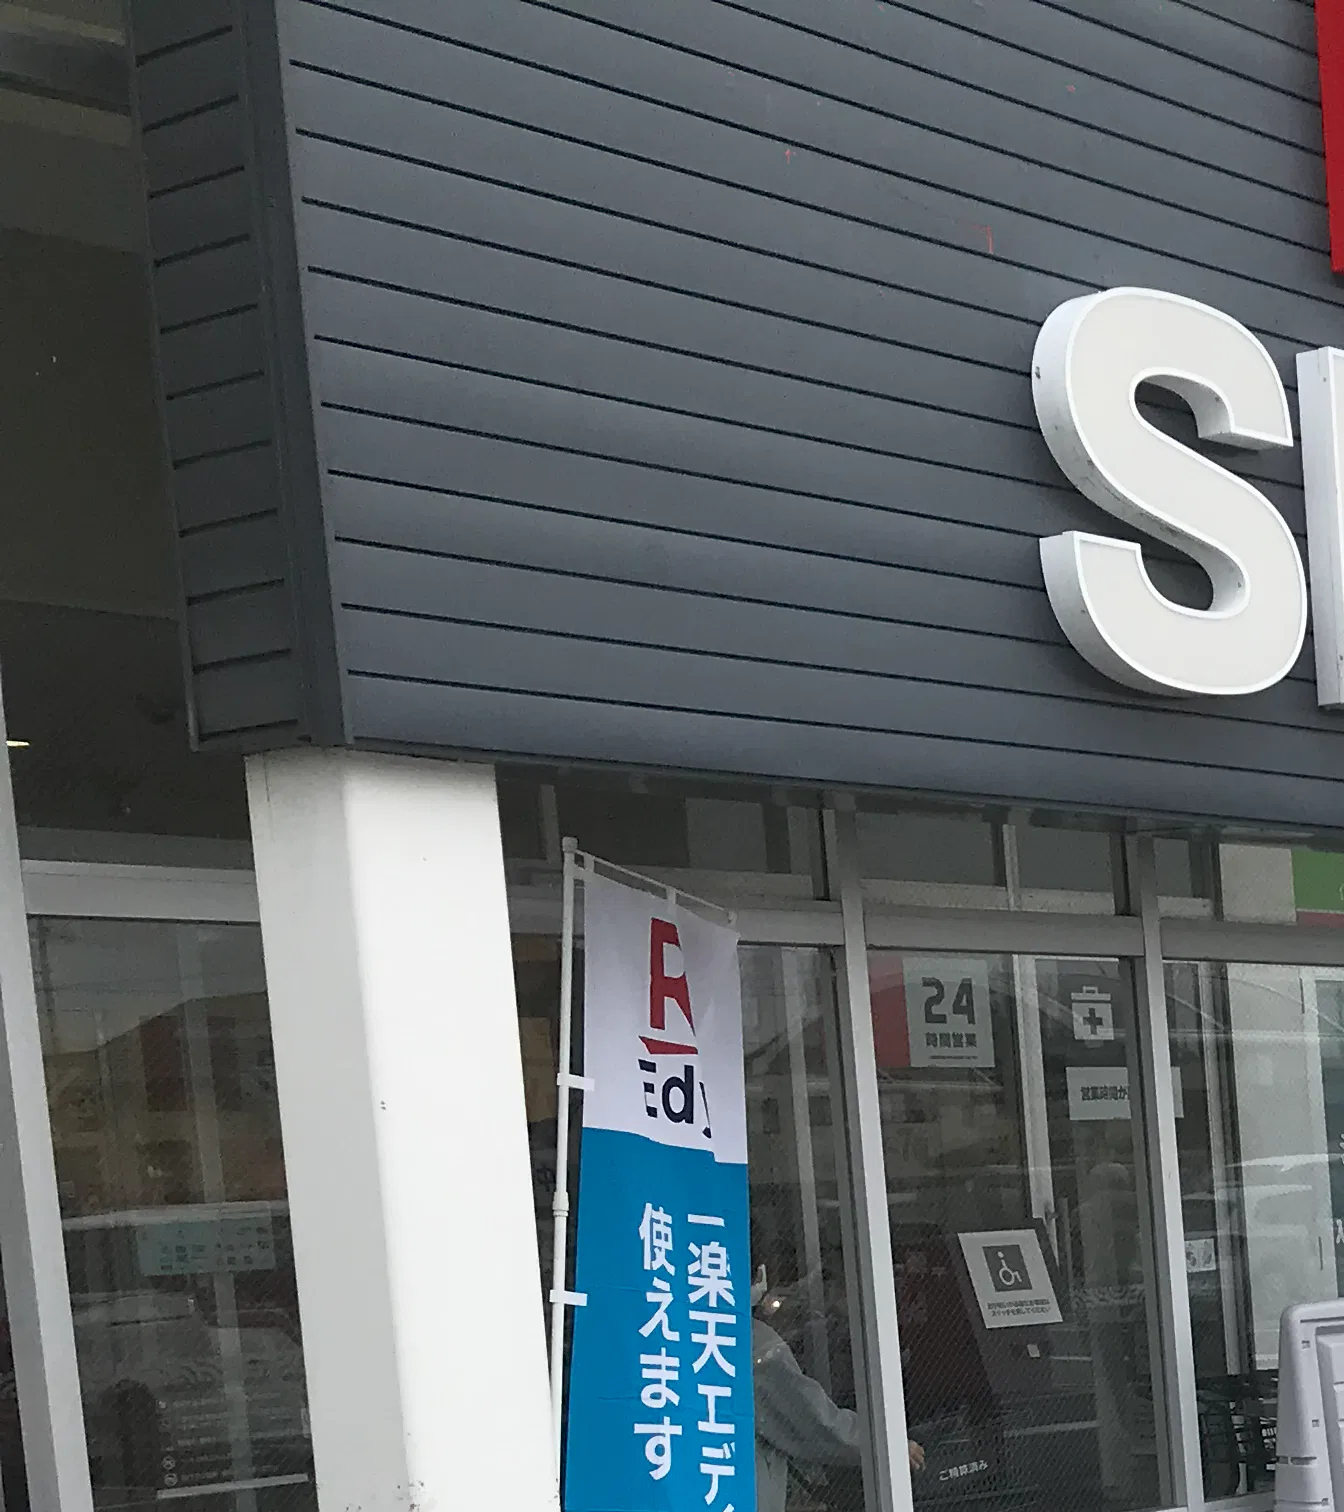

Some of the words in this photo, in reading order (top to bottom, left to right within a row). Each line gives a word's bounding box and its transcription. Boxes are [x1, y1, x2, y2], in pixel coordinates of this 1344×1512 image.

[921, 976, 976, 1025] 24
[925, 1032, 977, 1049] 時間営業
[633, 1202, 683, 1481] 使えます
